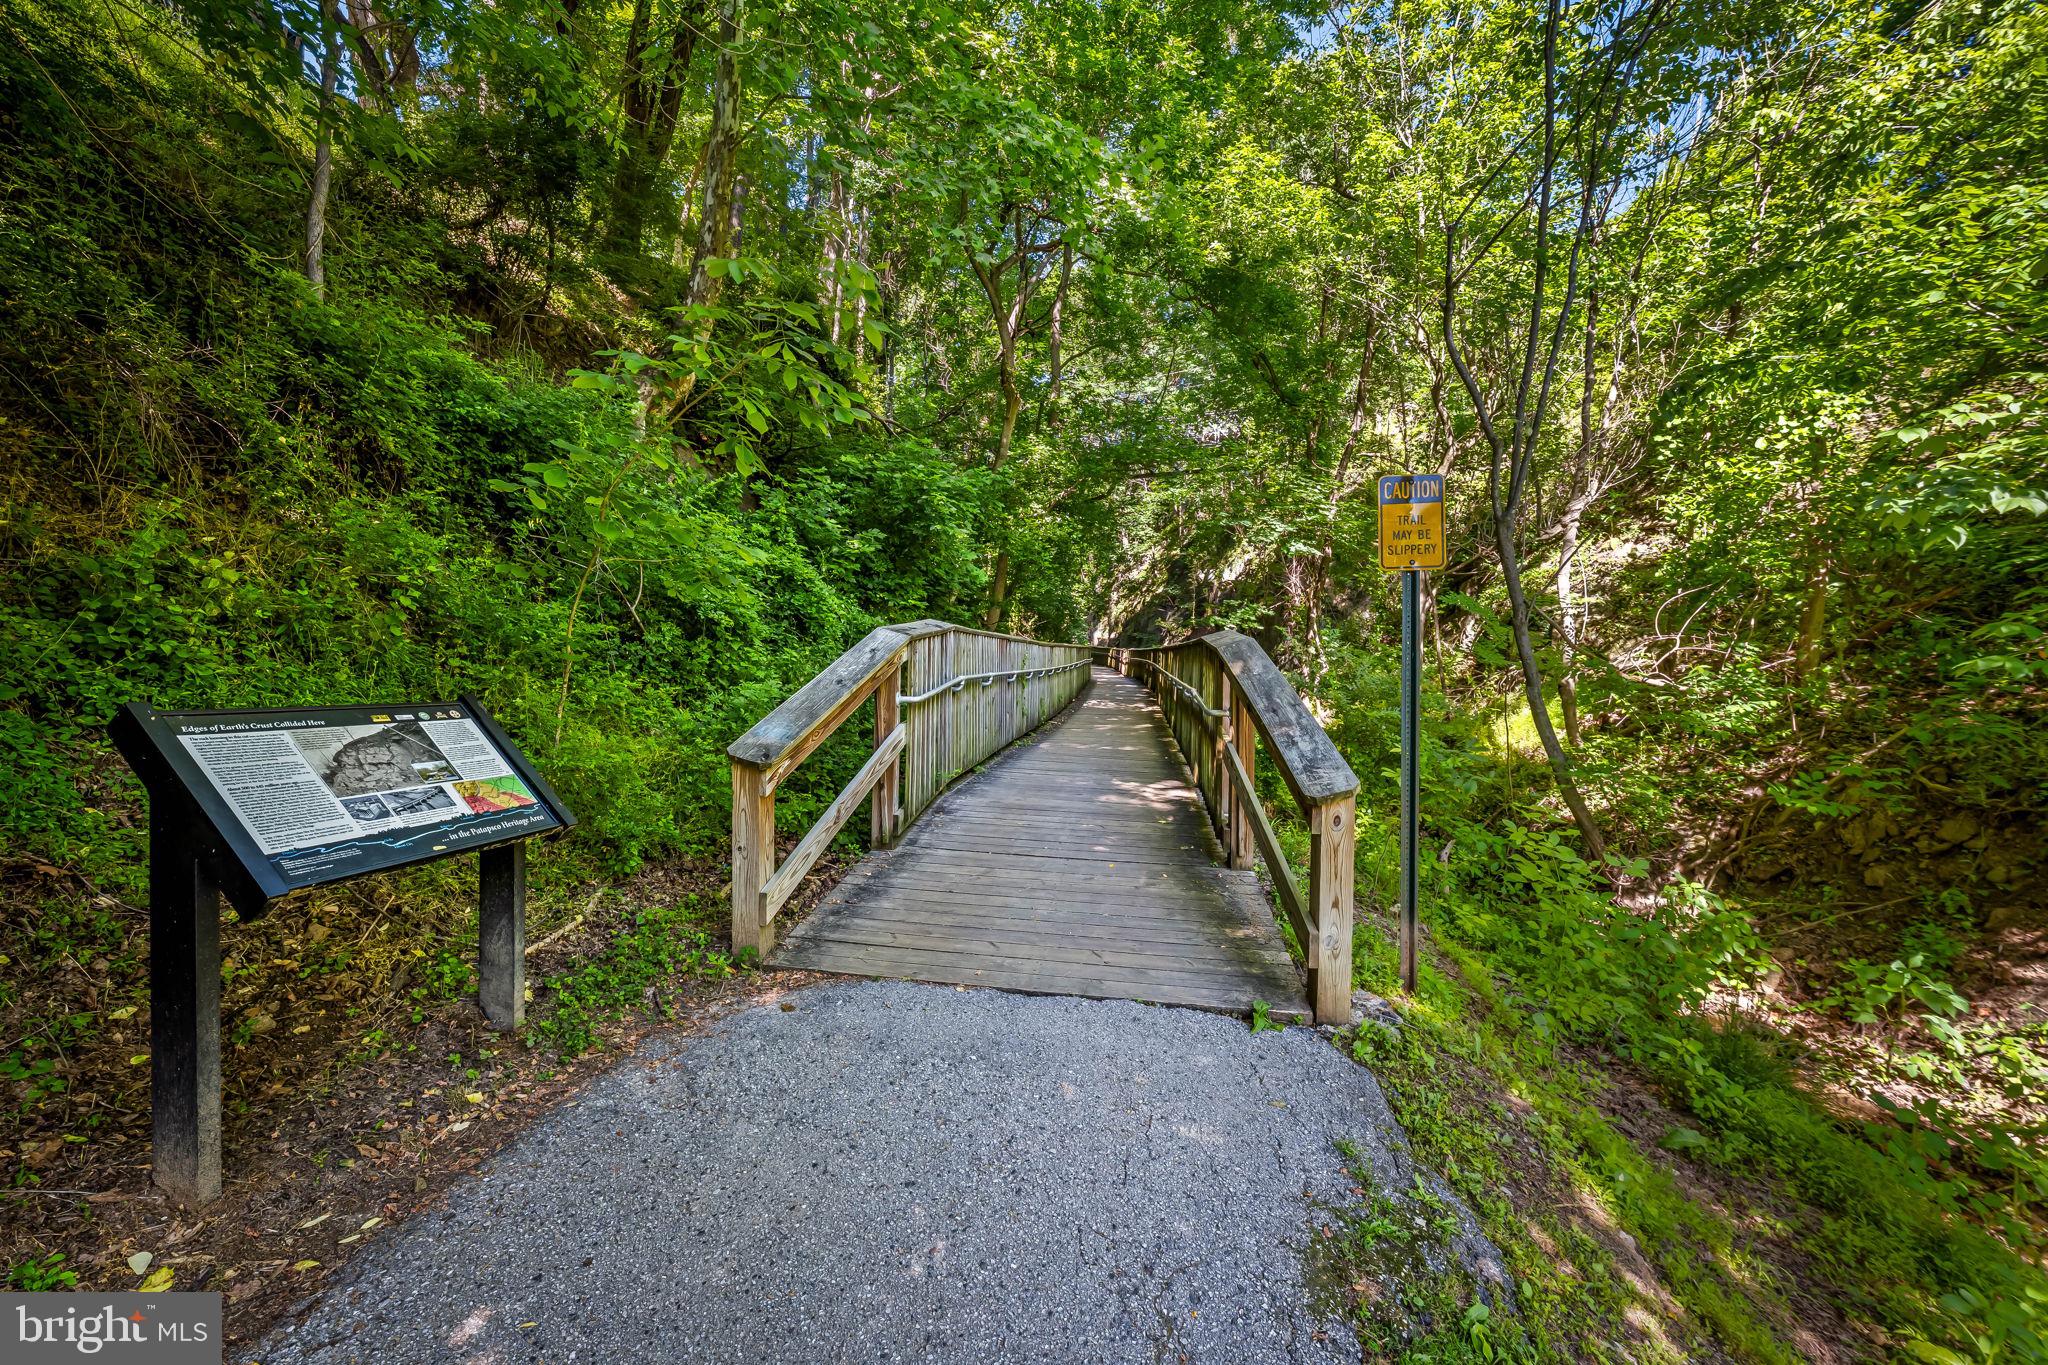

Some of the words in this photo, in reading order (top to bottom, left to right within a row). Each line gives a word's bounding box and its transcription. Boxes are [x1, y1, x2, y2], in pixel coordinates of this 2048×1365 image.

[1384, 480, 1440, 499] CAUTION
[1397, 515, 1427, 526] TRAIL
[1392, 530, 1413, 541] MAY
[1417, 529, 1432, 540] BE
[1387, 543, 1437, 556] SLIPPERY
[181, 726, 208, 734] Edges
[209, 724, 219, 733] of
[250, 722, 273, 730] Crust
[274, 720, 307, 728] Collided
[307, 719, 326, 727] Here
[449, 832, 459, 841] in
[459, 829, 471, 838] the
[470, 823, 502, 836] Patapsco
[501, 817, 530, 829] Heritage
[529, 813, 545, 822] Area
